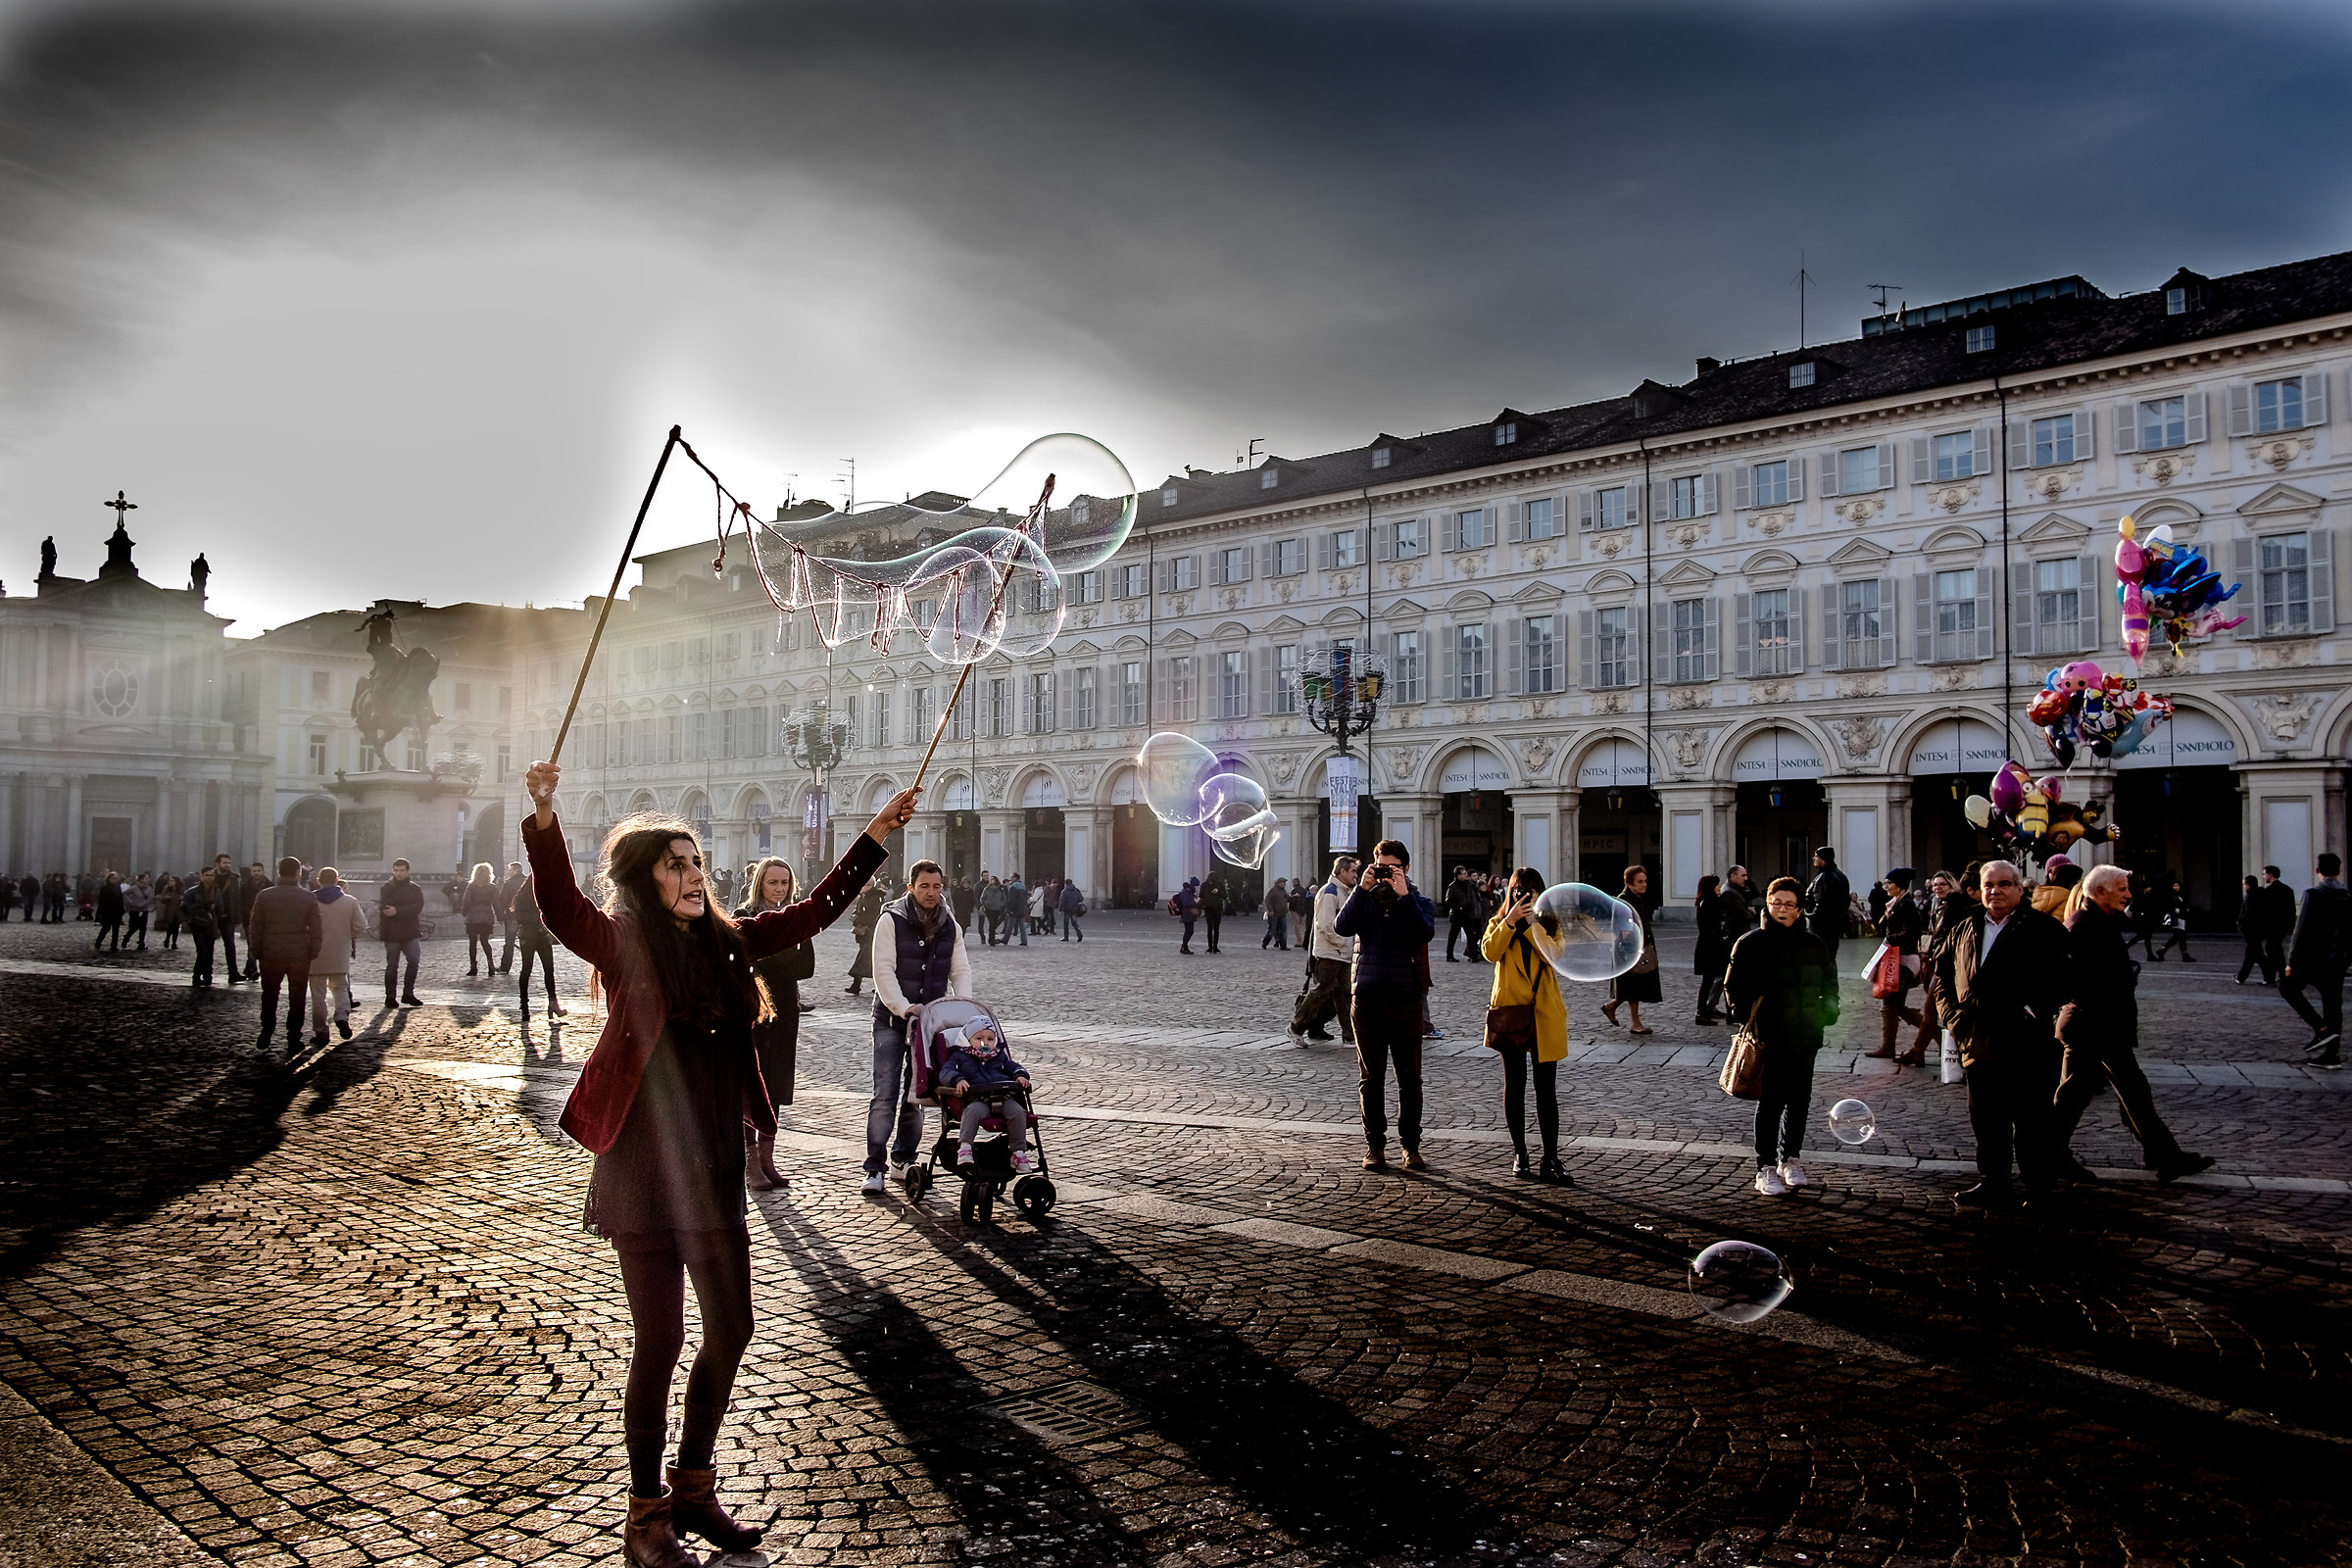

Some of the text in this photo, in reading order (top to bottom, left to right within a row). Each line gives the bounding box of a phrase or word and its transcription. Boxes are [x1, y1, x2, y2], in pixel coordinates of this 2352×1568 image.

[2176, 740, 2233, 753] SANPAOLO
[1915, 750, 2015, 761] INTESA SANPAOL
[1737, 761, 1765, 770] INTESA
